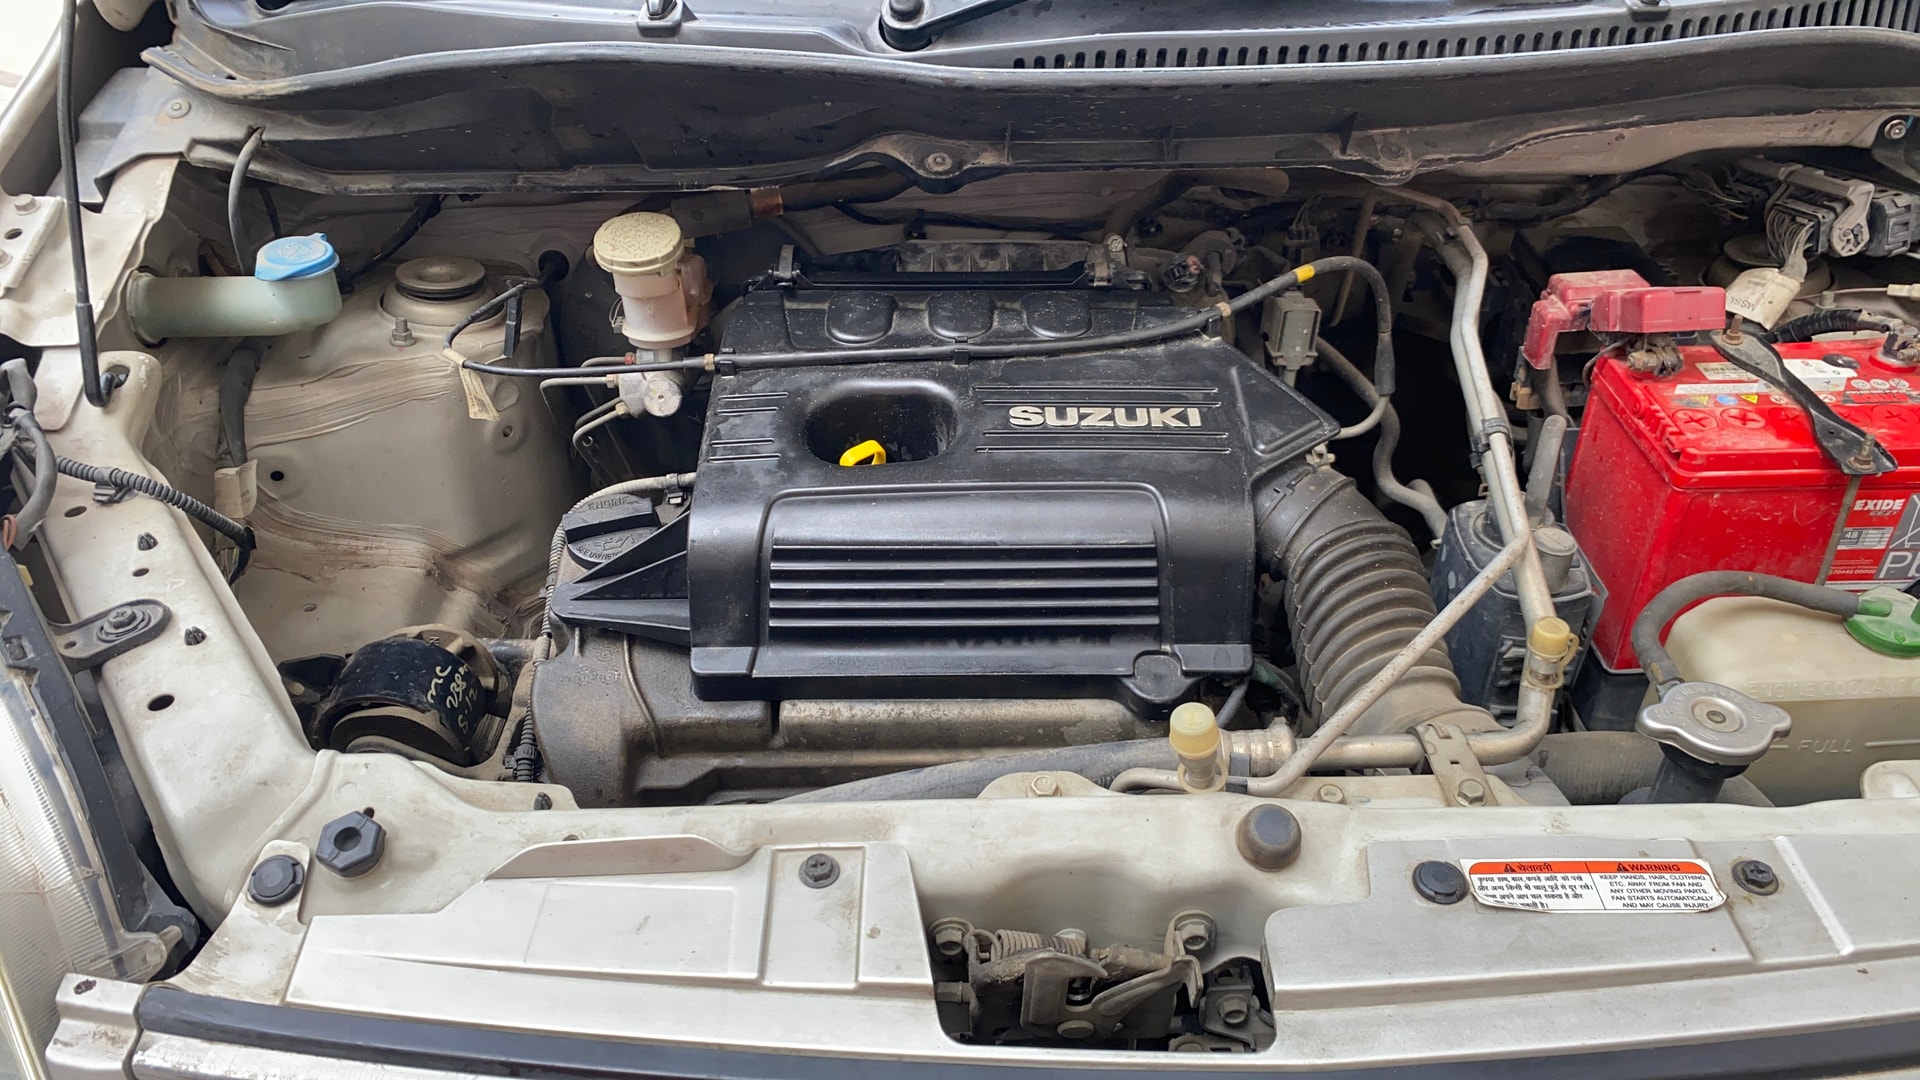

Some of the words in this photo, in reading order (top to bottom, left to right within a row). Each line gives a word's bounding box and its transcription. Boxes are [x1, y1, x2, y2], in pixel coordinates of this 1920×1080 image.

[1009, 405, 1202, 428] SUZUKI
[1853, 499, 1906, 511] EXIDE
[1844, 531, 1859, 539] 48
[1797, 739, 1853, 754] FULL
[1517, 863, 1553, 872] चेतावनी
[1628, 864, 1681, 872] WARNING
